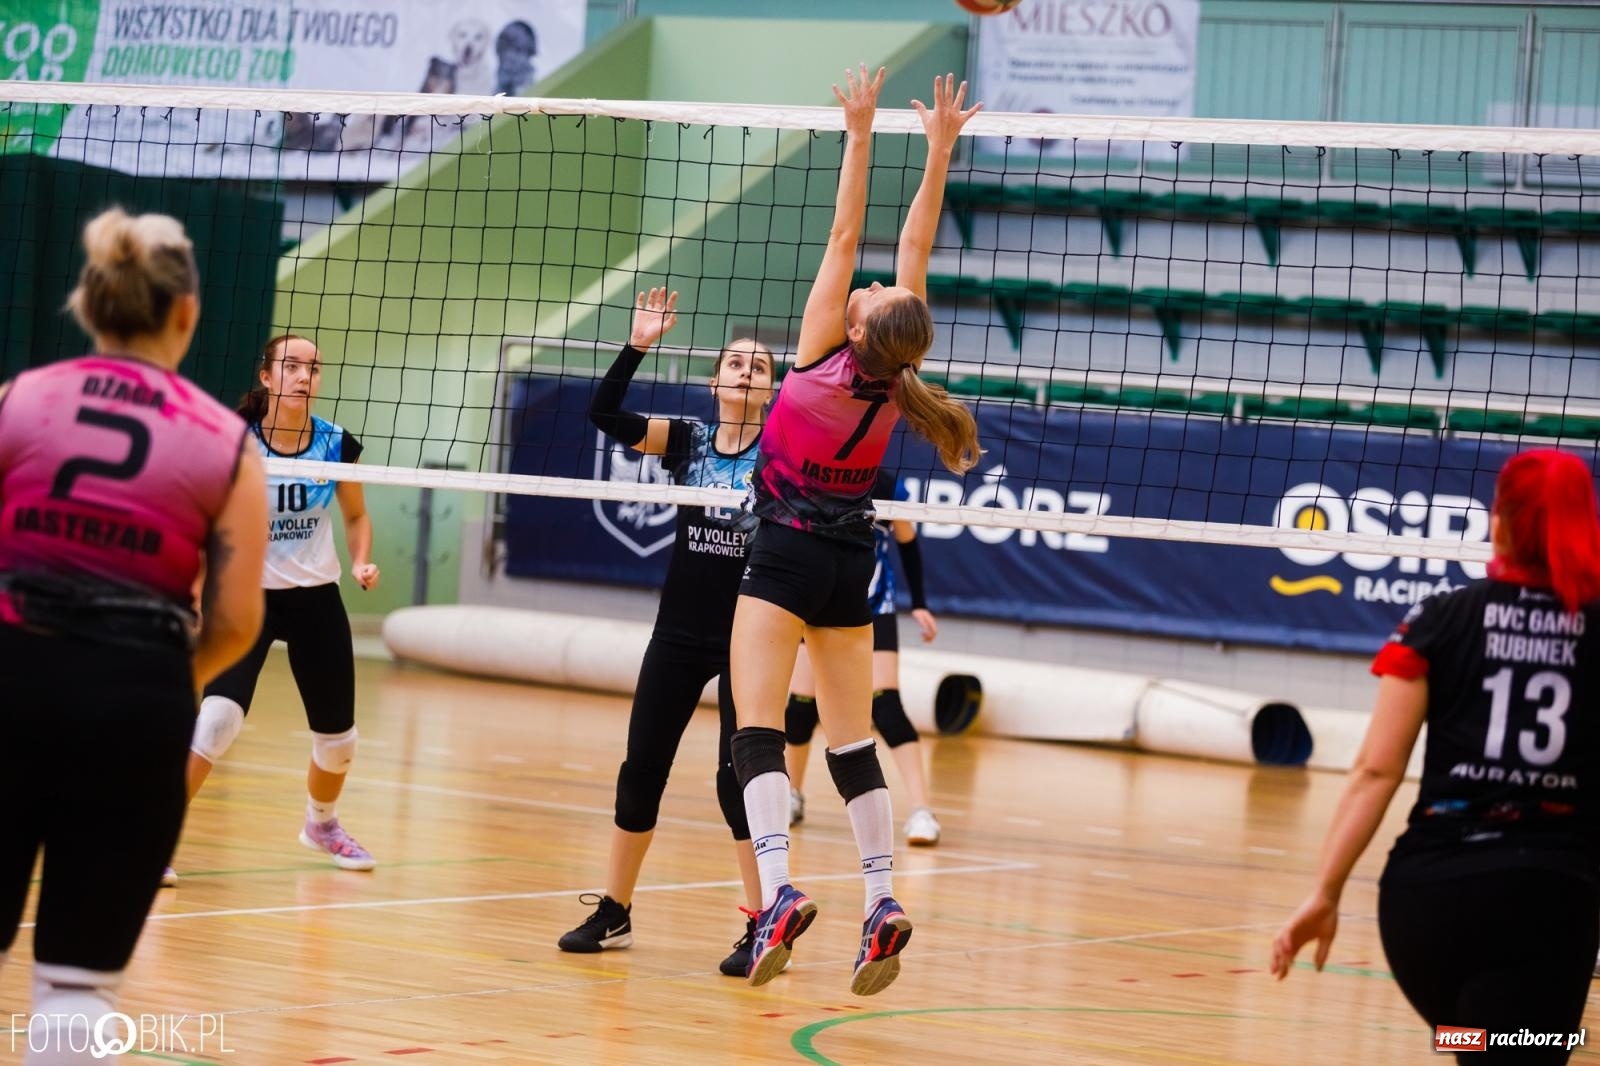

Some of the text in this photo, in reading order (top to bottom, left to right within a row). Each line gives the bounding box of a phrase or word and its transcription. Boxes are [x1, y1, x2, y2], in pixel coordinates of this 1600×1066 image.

[114, 6, 232, 41] WSZYSTKO
[237, 9, 278, 42] DLA
[1006, 0, 1172, 38] MIESZKO
[0, 22, 77, 62] OO
[101, 44, 241, 81] DOMOWEGO
[834, 391, 889, 460] 7
[49, 405, 153, 501] 2
[277, 483, 308, 513] 10
[277, 517, 320, 532] VOLLEY
[688, 525, 748, 546] PV VOLLEY
[688, 540, 745, 557] KRAPKOWICE
[1483, 603, 1586, 636] BVC GANG
[1485, 632, 1578, 667] RUBINEK
[1482, 667, 1572, 766] 13
